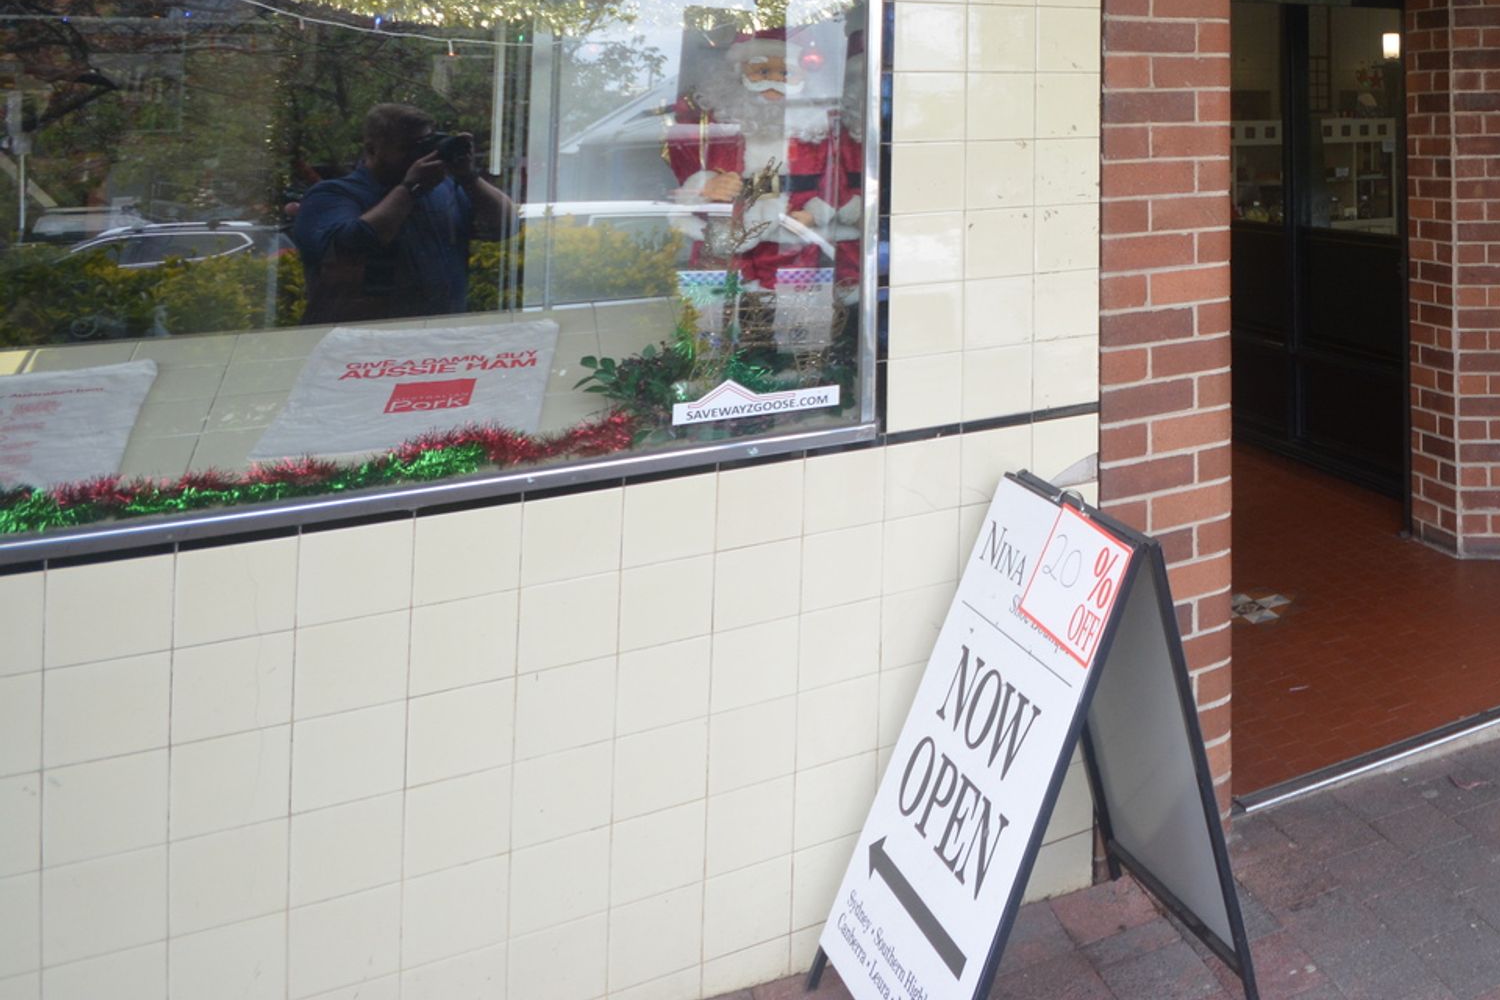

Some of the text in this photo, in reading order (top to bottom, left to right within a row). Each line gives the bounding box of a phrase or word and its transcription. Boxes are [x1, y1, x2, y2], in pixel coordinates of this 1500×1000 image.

[338, 357, 538, 381] AUSSIE HAM
[346, 359, 397, 370] GIVE
[401, 359, 417, 367] A
[496, 350, 539, 360] BUY
[388, 396, 464, 413] Pork
[686, 395, 828, 421] SAVEWAYZGOOSE.COM
[1067, 604, 1101, 652] OFF
[935, 645, 1042, 781] NOW
[899, 736, 1009, 901] OPEN
[847, 889, 873, 934] Sydney
